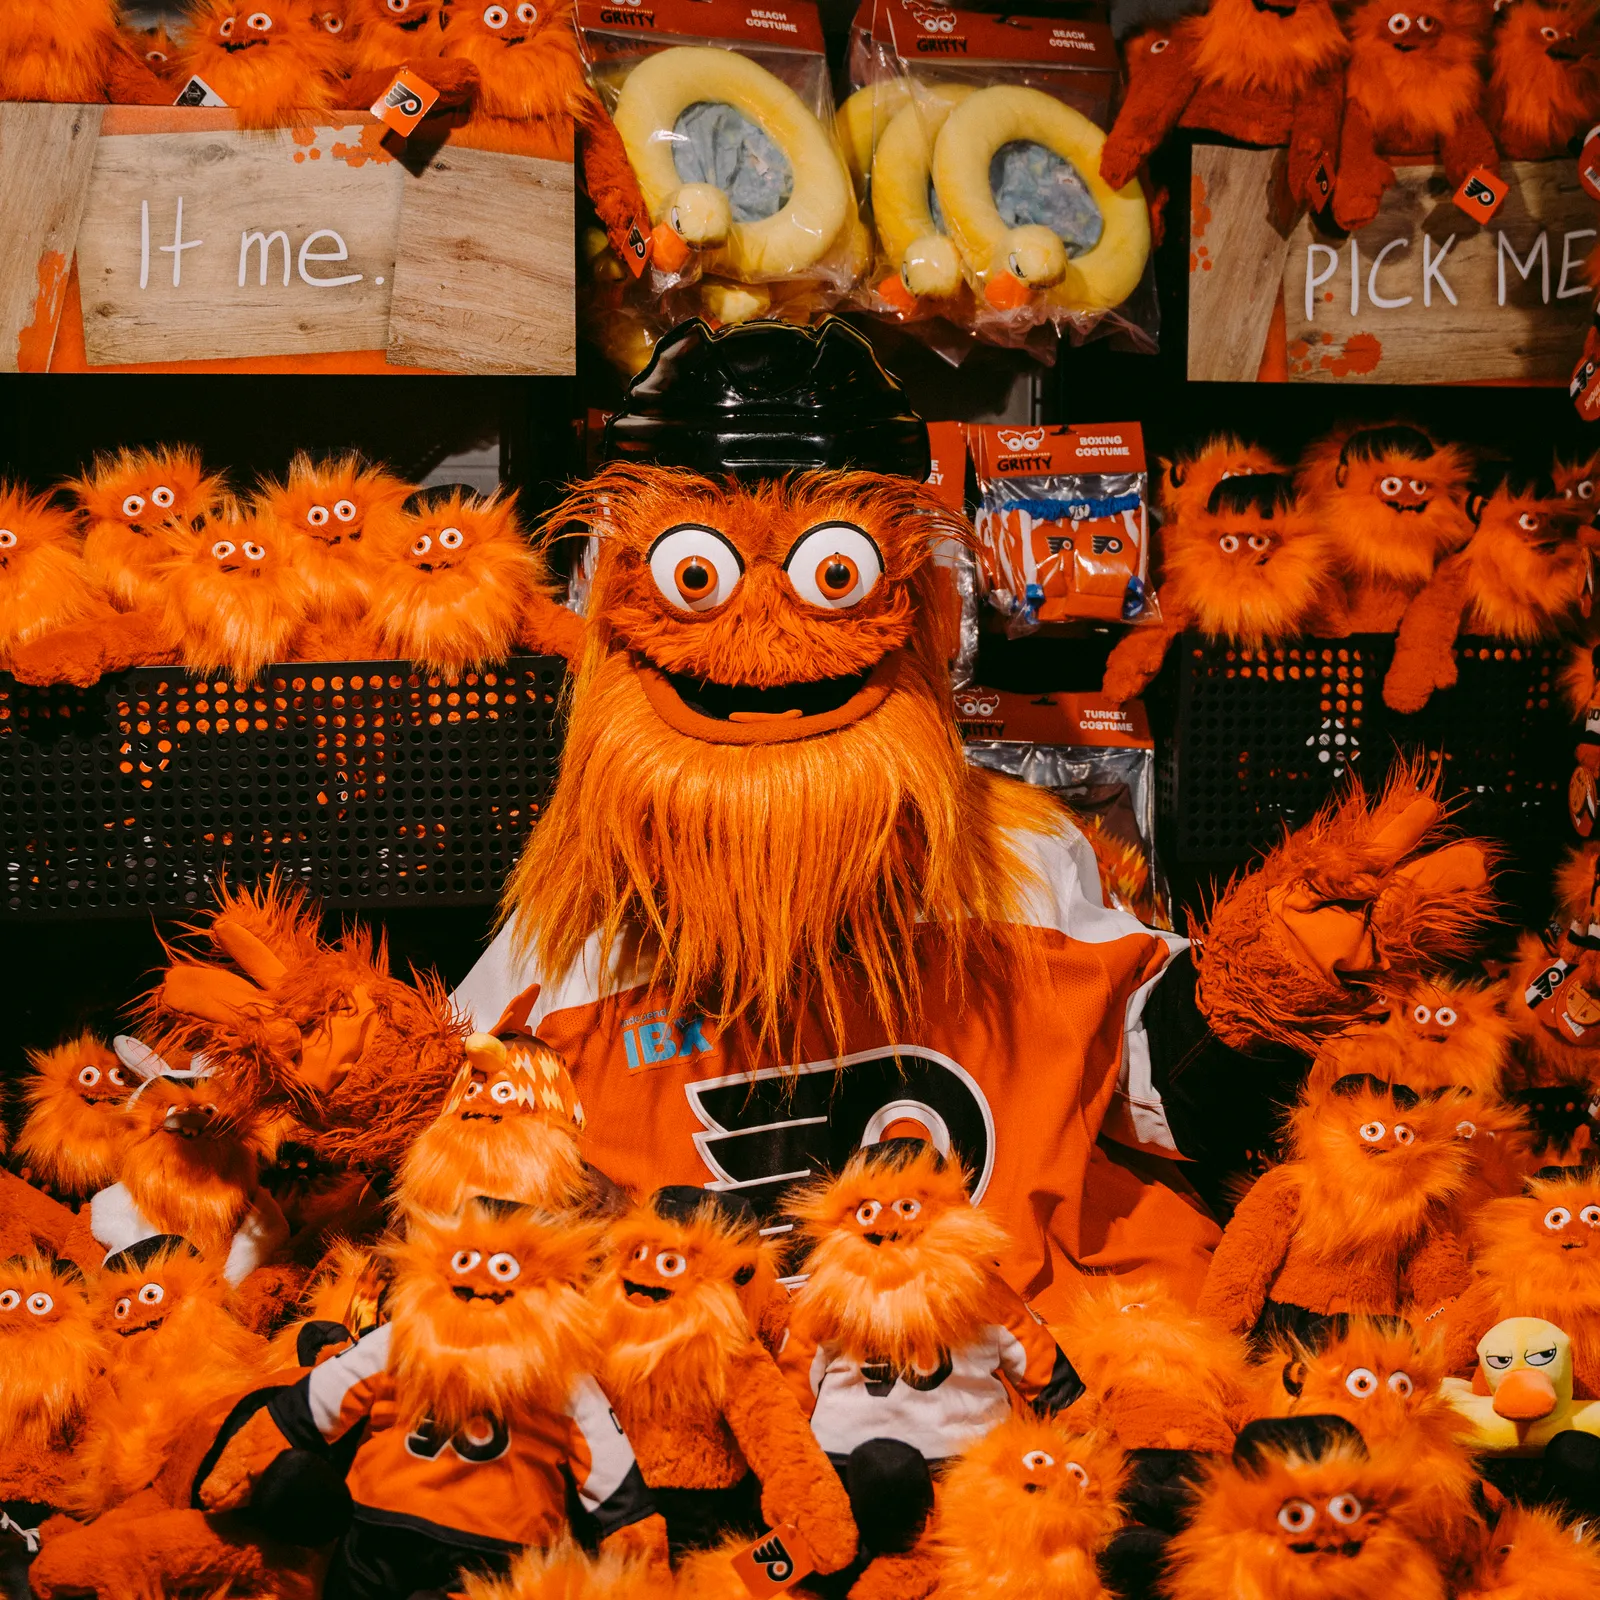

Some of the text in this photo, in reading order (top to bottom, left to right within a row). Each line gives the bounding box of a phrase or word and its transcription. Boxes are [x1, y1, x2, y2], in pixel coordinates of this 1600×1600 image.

[600, 10, 655, 28] GRITTY
[751, 9, 787, 21] BEACH
[746, 18, 798, 33] COSTUME
[1052, 29, 1086, 40] BEACH
[916, 38, 968, 53] GRITTY
[1049, 38, 1096, 51] COSTUME
[139, 196, 385, 289] It me.
[1304, 228, 1598, 321] PICK ME
[1080, 435, 1122, 446] BOXING
[1075, 446, 1130, 457] COSTUME
[997, 456, 1052, 472] GRITTY
[1083, 709, 1127, 720] TURKEY
[961, 722, 1006, 737] RITTY
[1079, 720, 1134, 732] COSTUME
[623, 1015, 713, 1069] IBX
